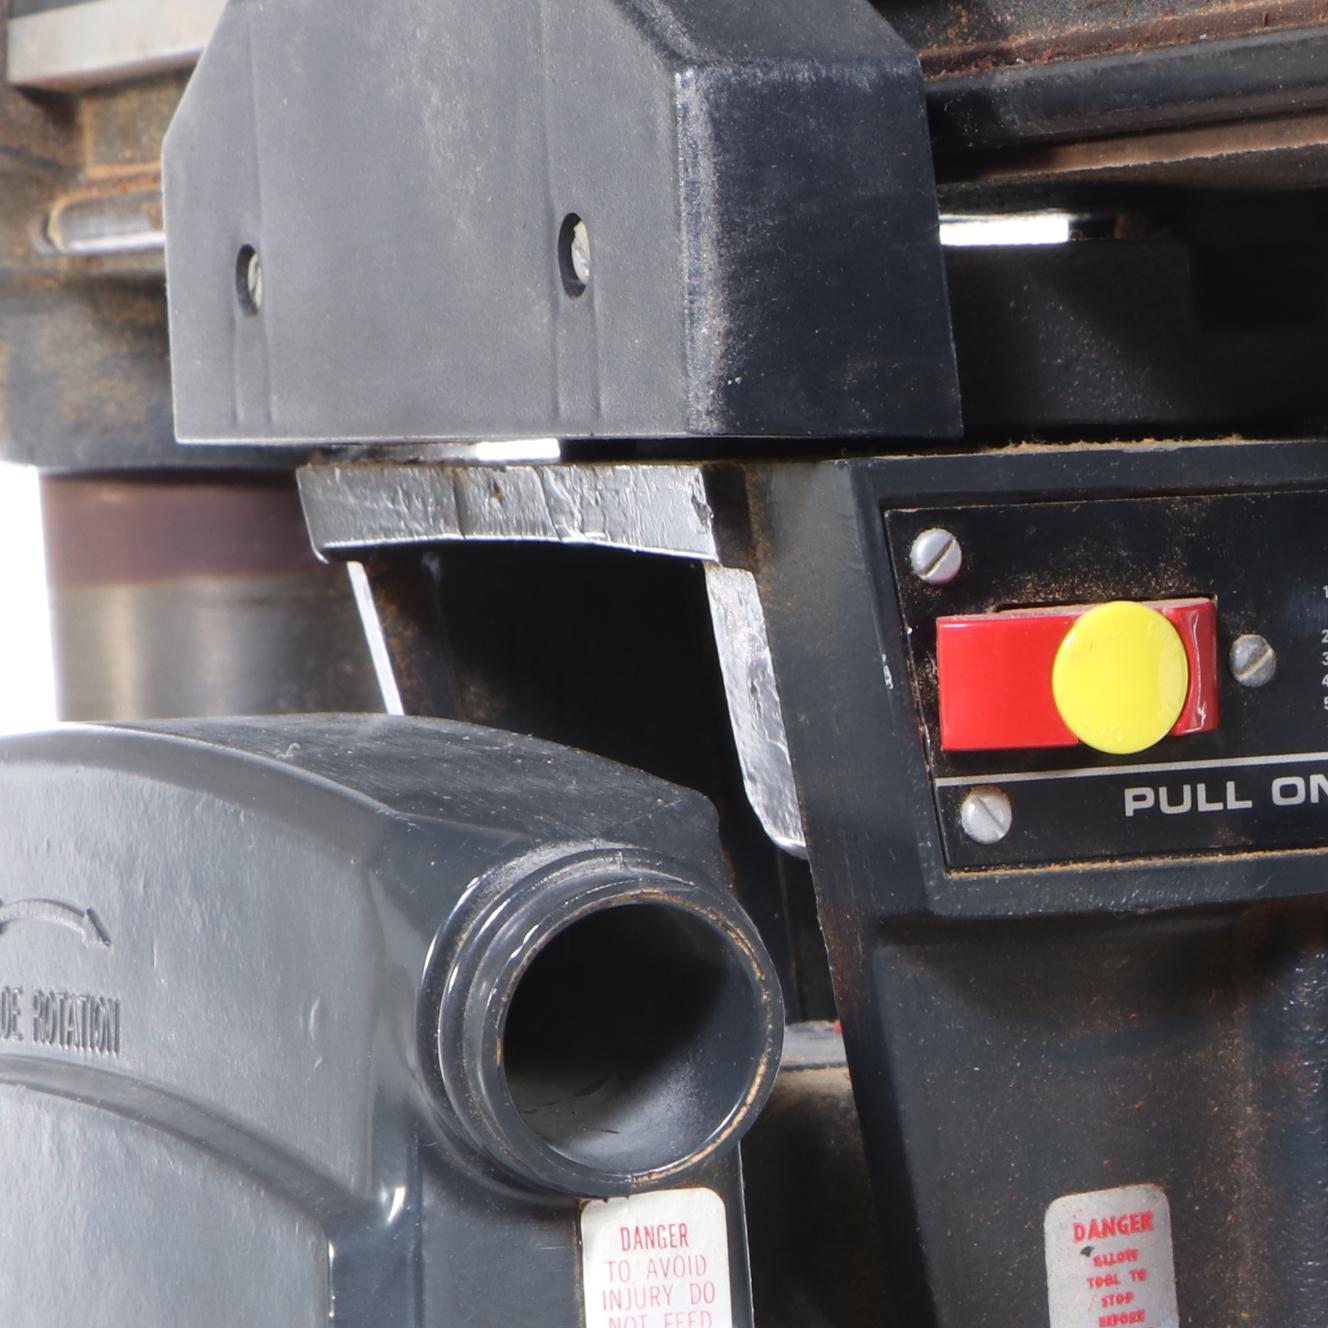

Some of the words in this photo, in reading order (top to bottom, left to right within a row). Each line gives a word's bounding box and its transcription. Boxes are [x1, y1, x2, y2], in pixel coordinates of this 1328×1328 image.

[1124, 780, 1253, 817] PULL
[33, 988, 120, 1054] ROTATION
[620, 1222, 689, 1253] DANGER
[1073, 1211, 1155, 1243] DANGER
[607, 1259, 631, 1283] TO
[646, 1253, 708, 1280] AVOID
[1087, 1274, 1121, 1289] TOOL
[1129, 1268, 1147, 1282] TO
[602, 1283, 674, 1312] INJURY
[690, 1280, 716, 1305] DO
[1101, 1291, 1135, 1308] STOP
[1099, 1309, 1147, 1328] BEFORE
